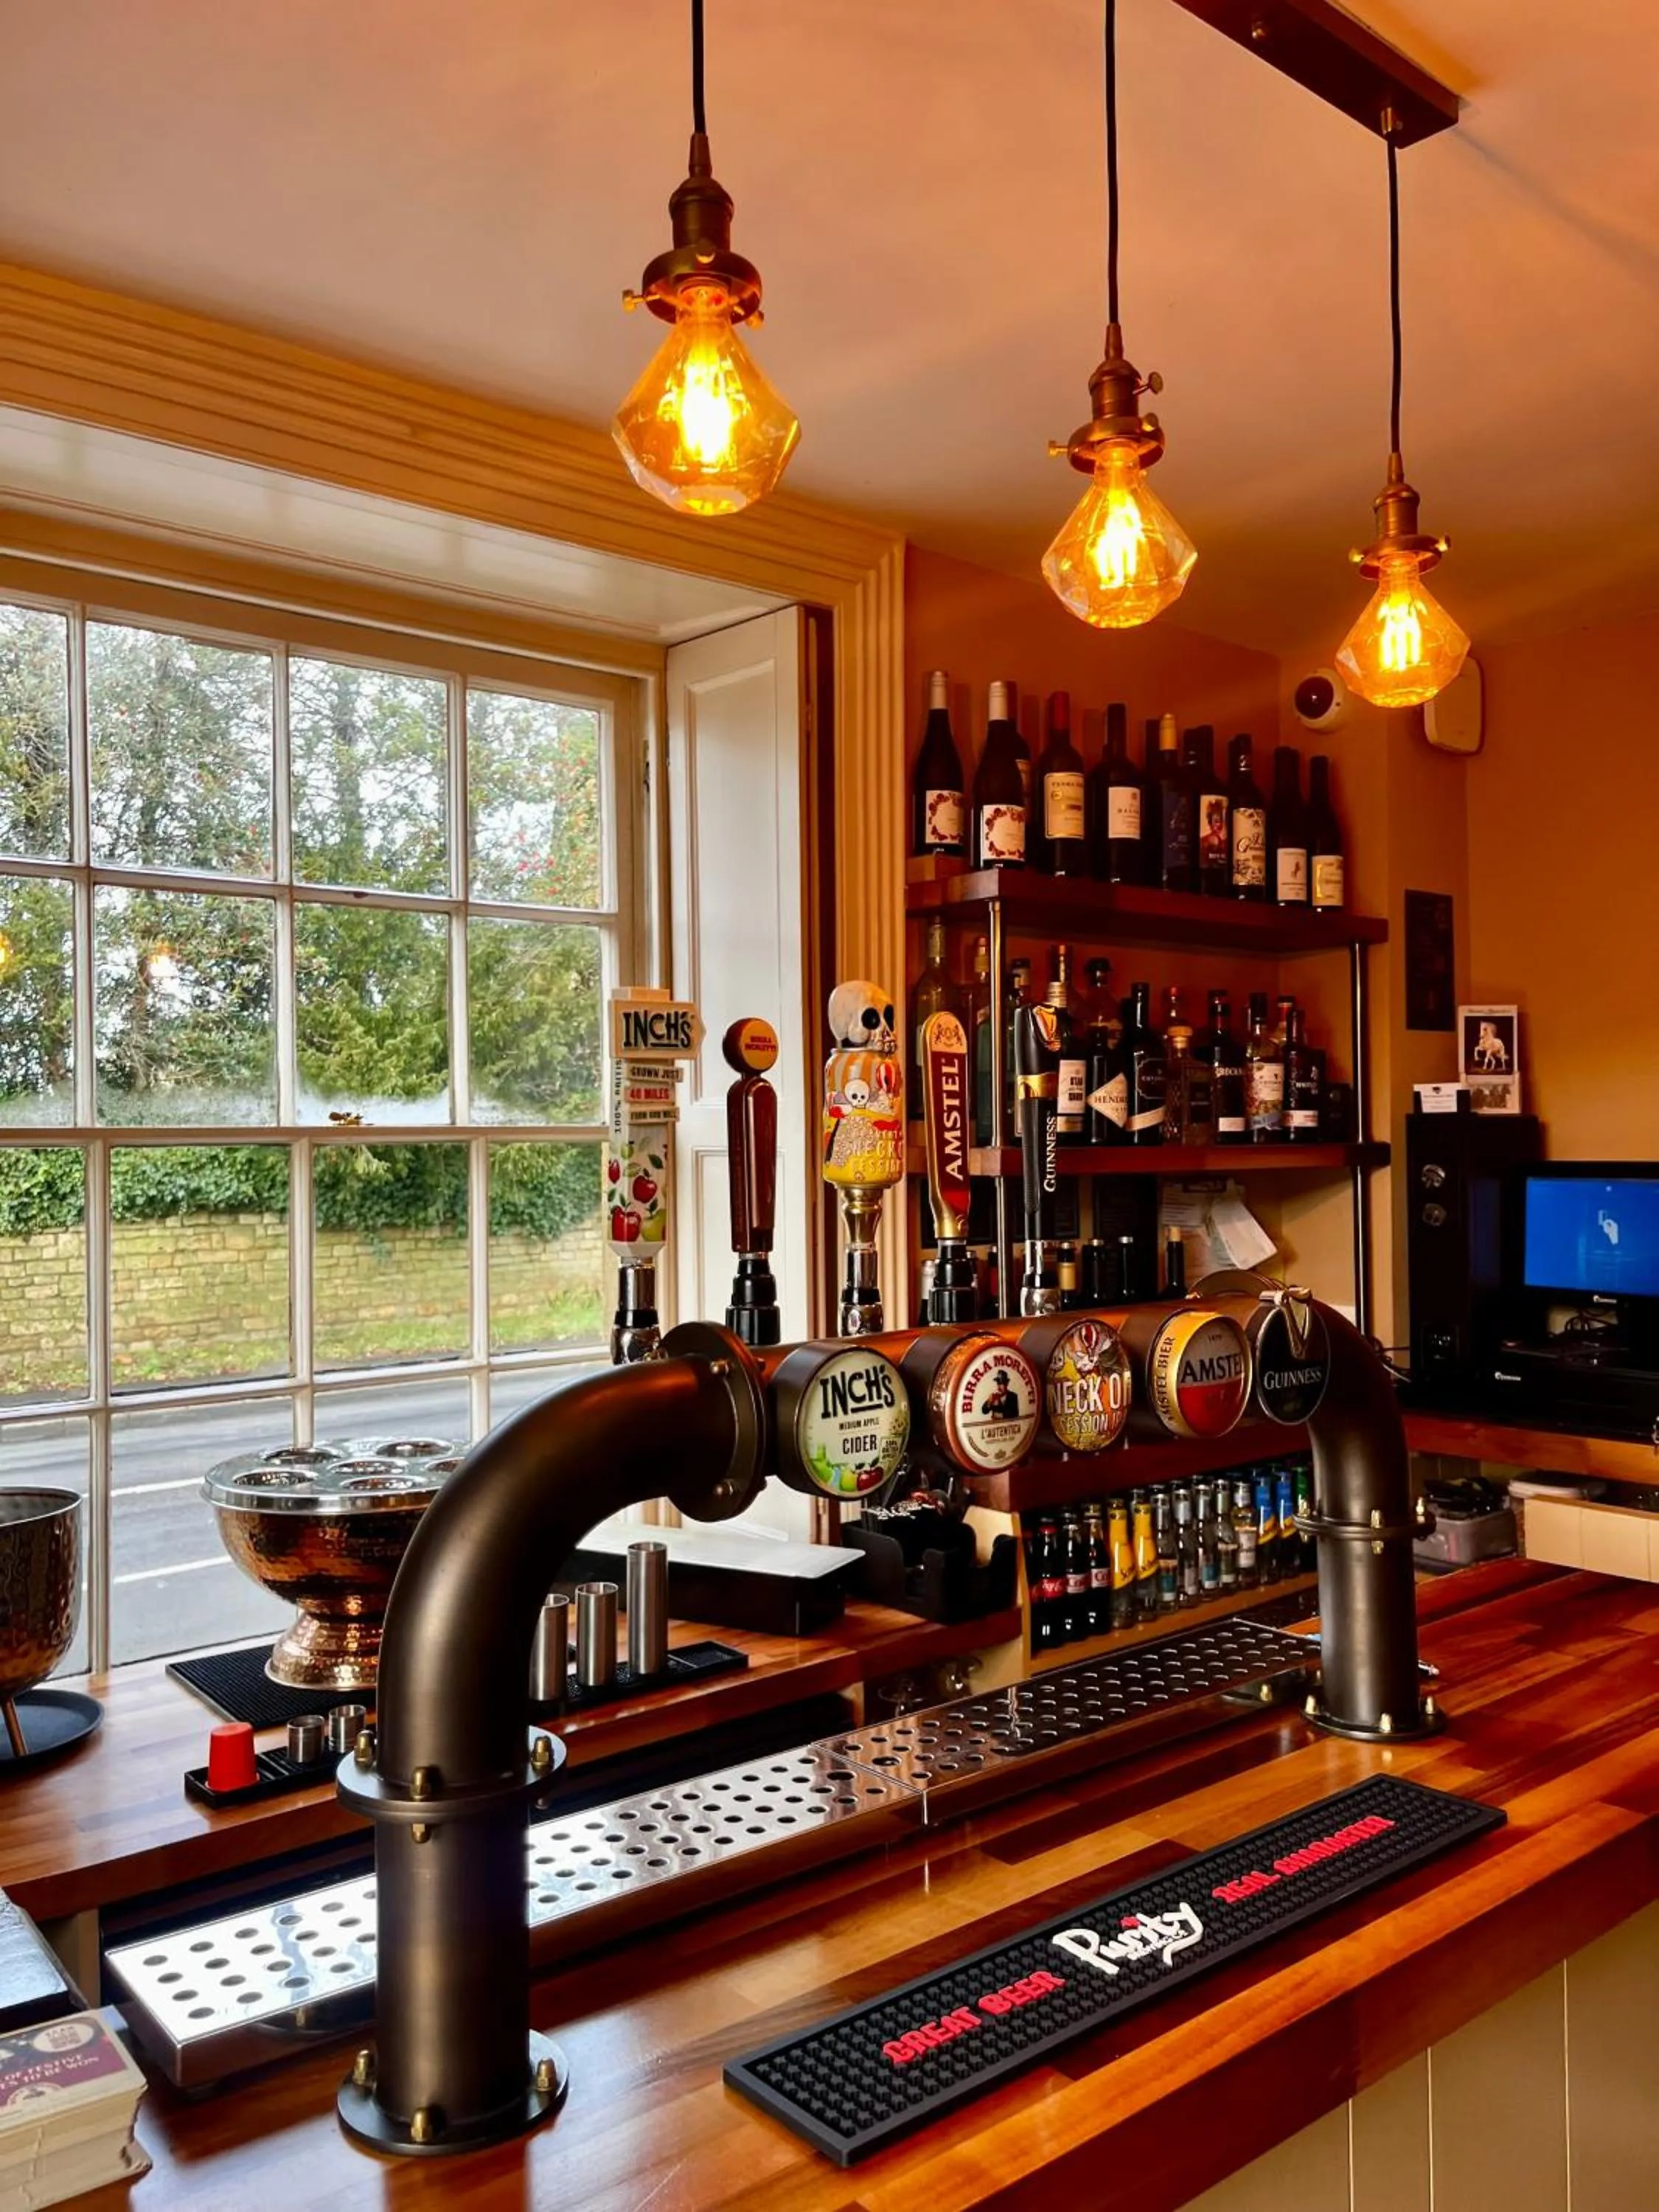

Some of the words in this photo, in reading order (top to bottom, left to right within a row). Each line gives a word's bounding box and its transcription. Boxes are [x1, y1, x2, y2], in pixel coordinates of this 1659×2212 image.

[644, 1088, 669, 1099] MILES
[942, 1058, 964, 1180] AMSTEL
[1043, 1116, 1057, 1192] GUINNESS
[1158, 1336, 1175, 1368] BIER
[820, 1365, 895, 1419] INCH'S
[961, 1360, 992, 1413] BIRRA
[993, 1354, 1035, 1405] MORETTI
[1046, 1376, 1103, 1415] NECK
[1263, 1366, 1322, 1391] GUINNESS
[838, 1419, 861, 1431] MEDIUM
[863, 1417, 879, 1427] APPLE
[842, 1434, 877, 1455] CIDER
[1060, 1413, 1108, 1434] SESSION
[1211, 1871, 1281, 1904] REAL
[1273, 1815, 1396, 1876] CHARACTER
[1051, 1901, 1204, 1975] Purity
[883, 2006, 982, 2065] GREAT
[978, 1970, 1066, 2017] BEER
